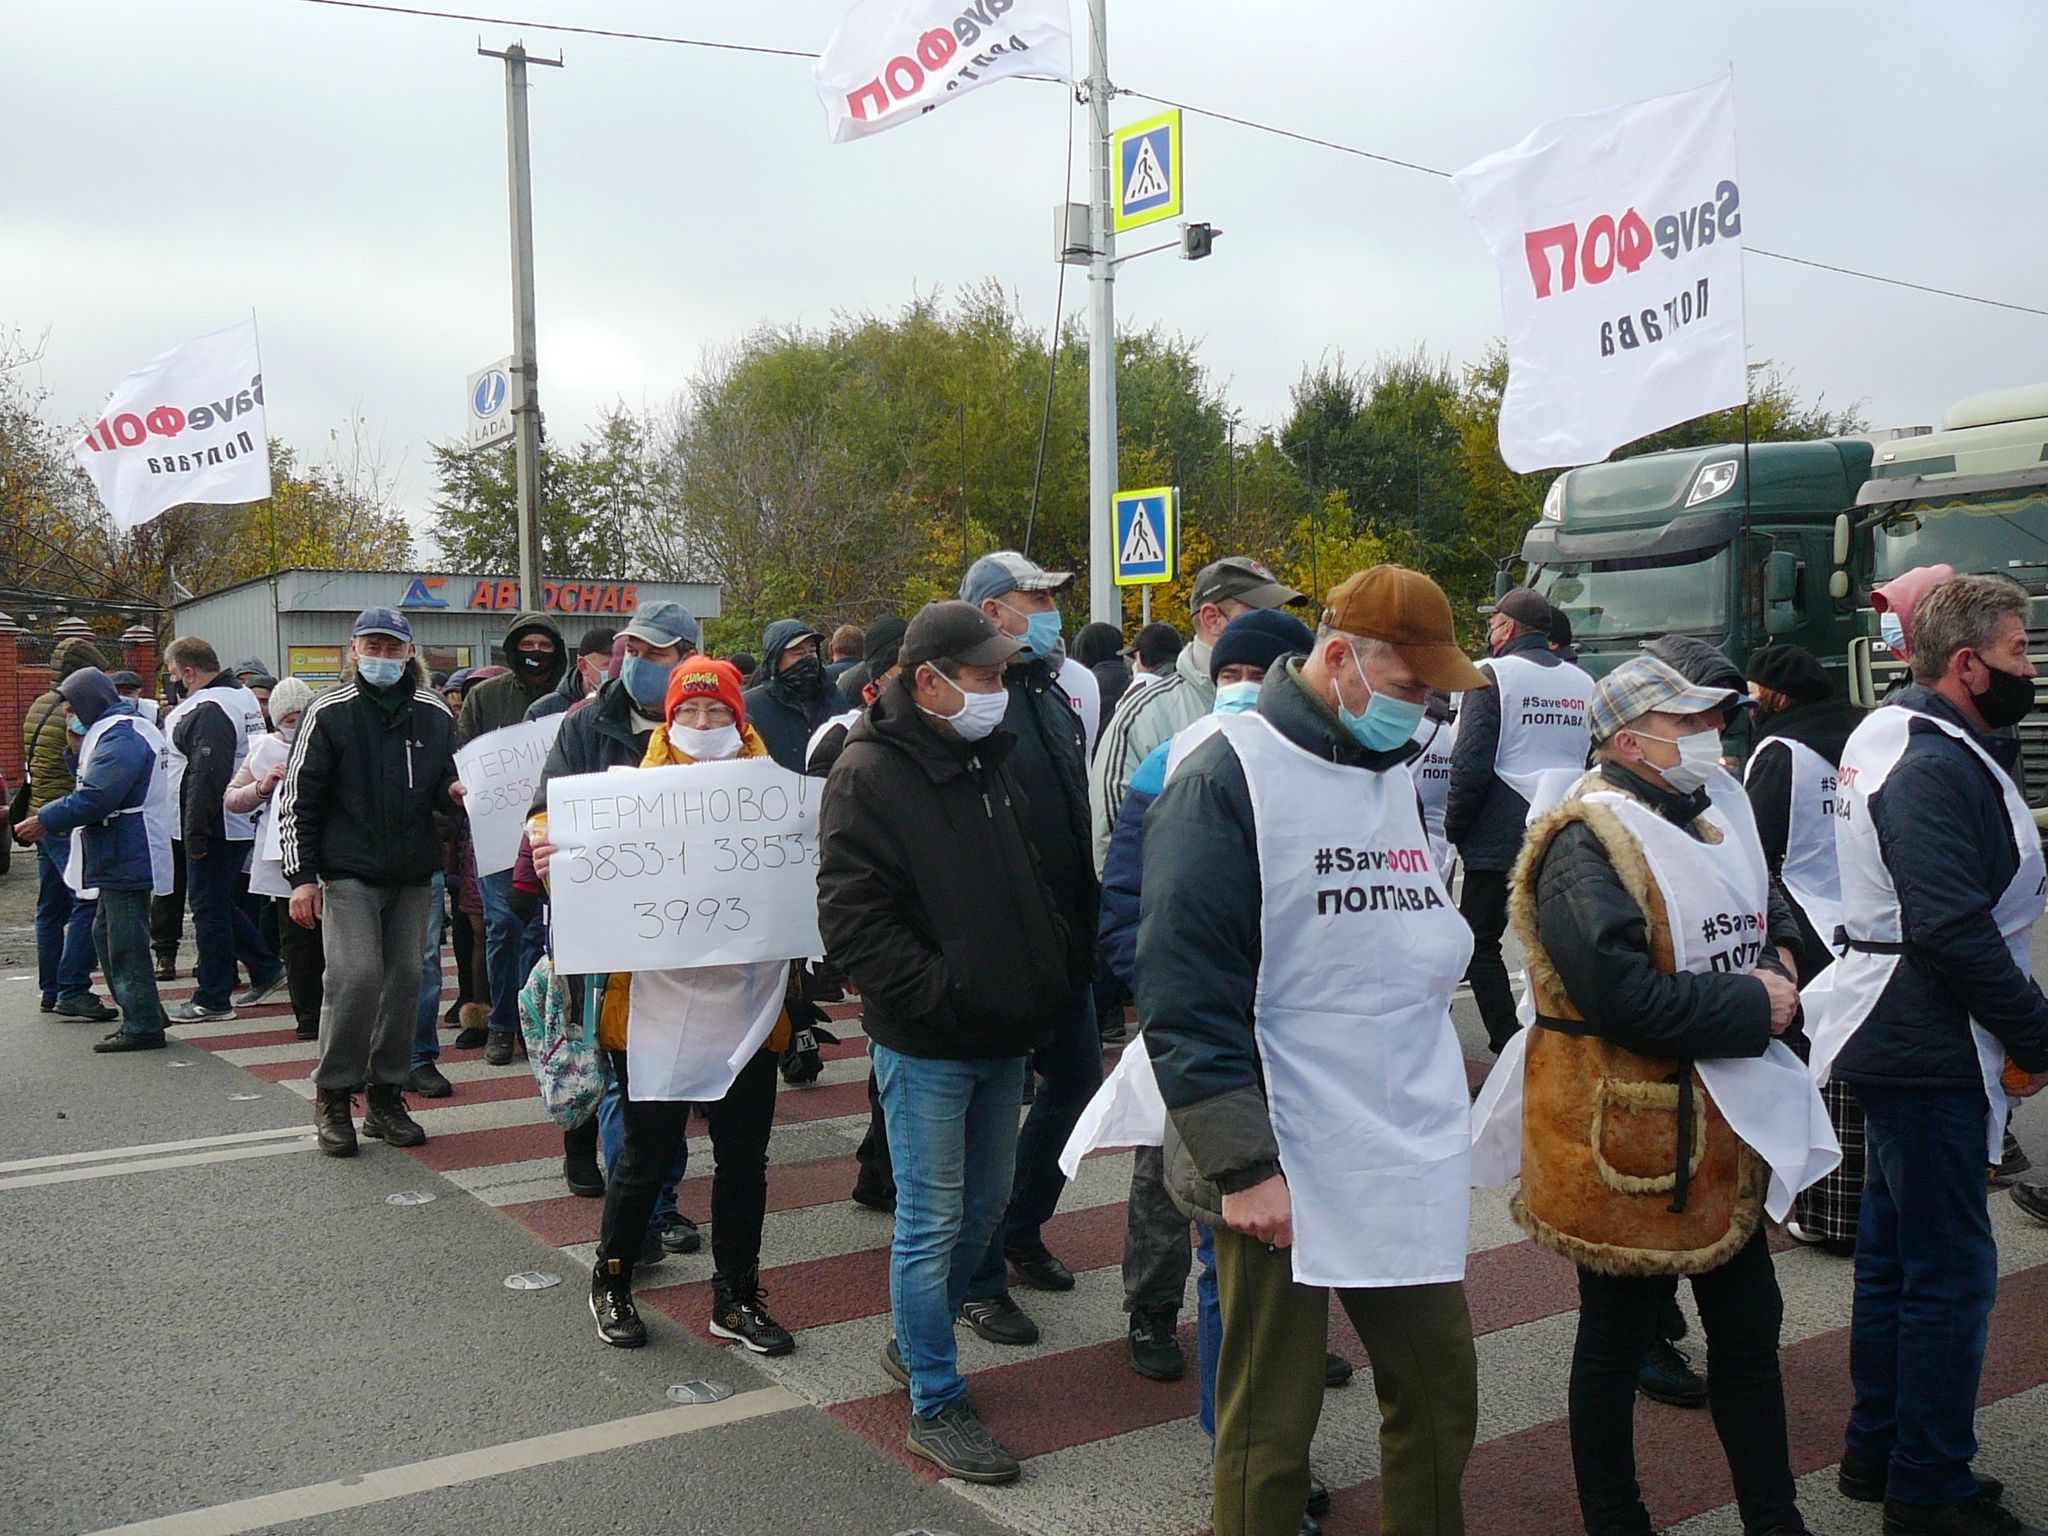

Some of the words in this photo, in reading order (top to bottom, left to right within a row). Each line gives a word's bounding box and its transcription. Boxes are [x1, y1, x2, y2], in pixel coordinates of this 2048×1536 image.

[474, 417, 507, 442] LADA
[469, 579, 640, 613] АВОСНАБ
[1521, 696, 1585, 711] #SaveФОП
[570, 841, 687, 884] 3853-1
[1317, 885, 1445, 915] ПОЛТАВА
[633, 897, 751, 940] 3993
